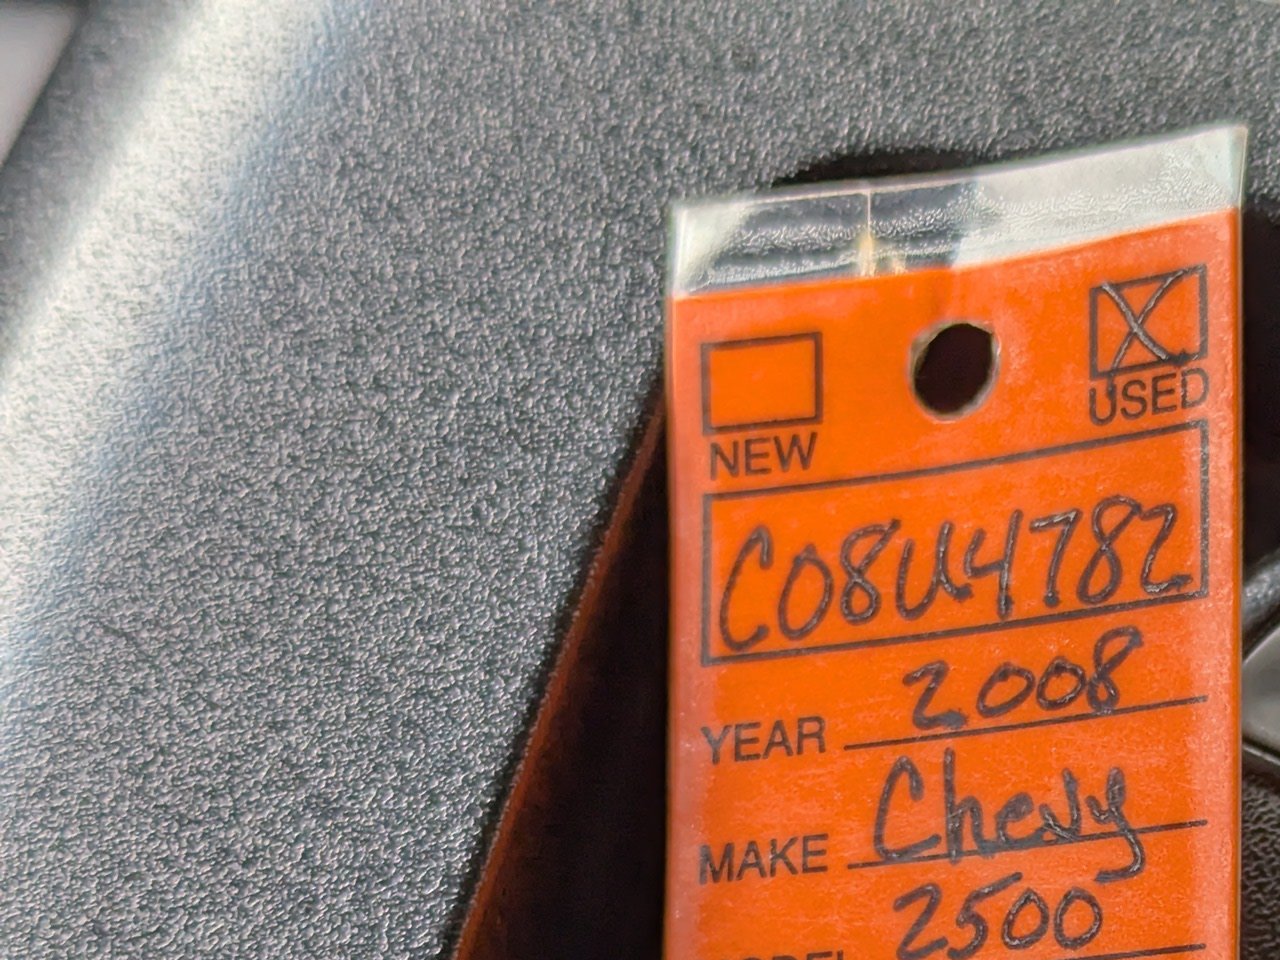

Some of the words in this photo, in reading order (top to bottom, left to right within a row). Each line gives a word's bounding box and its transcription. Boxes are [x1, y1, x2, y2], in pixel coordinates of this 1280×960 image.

[1089, 367, 1209, 426] USED
[709, 431, 818, 481] NEW
[902, 625, 1145, 731] 2008
[700, 716, 826, 766] YEAR
[873, 748, 1146, 882] Chevy
[699, 834, 829, 885] MAKE
